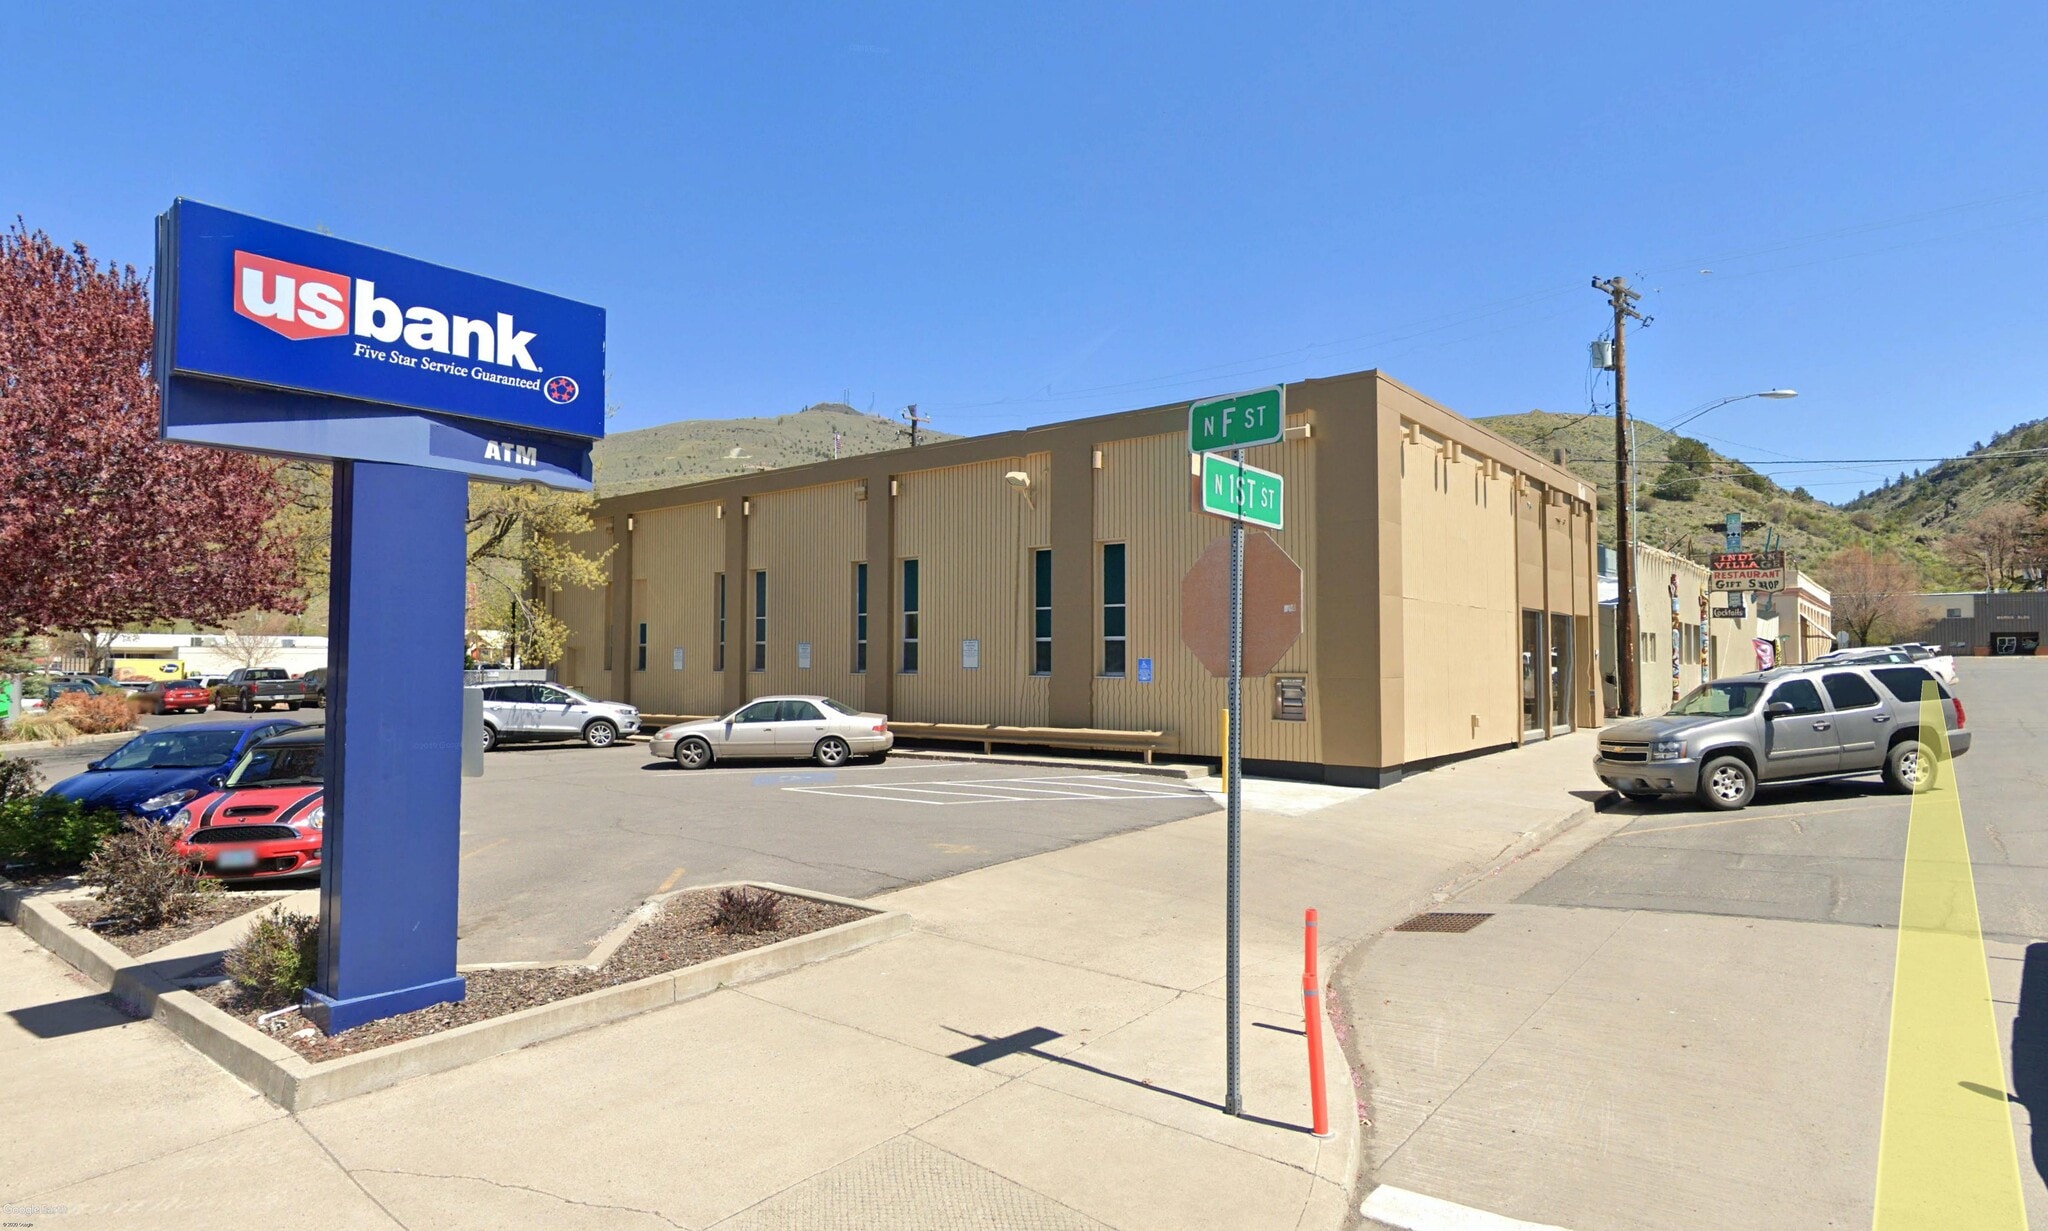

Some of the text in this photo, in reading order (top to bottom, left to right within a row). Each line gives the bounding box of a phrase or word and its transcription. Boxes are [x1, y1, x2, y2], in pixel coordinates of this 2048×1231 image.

[353, 342, 541, 391] Five Star Service Guaranteed
[1204, 405, 1266, 438] N F ST
[484, 440, 537, 467] ATM
[1215, 474, 1275, 509] N 1ST ST
[1719, 553, 1776, 561] INDIAN
[1714, 560, 1781, 569] VILLAGE
[1714, 570, 1781, 579] RESTAURANT
[1715, 580, 1742, 589] GIFT
[1713, 608, 1744, 617] Cocktails
